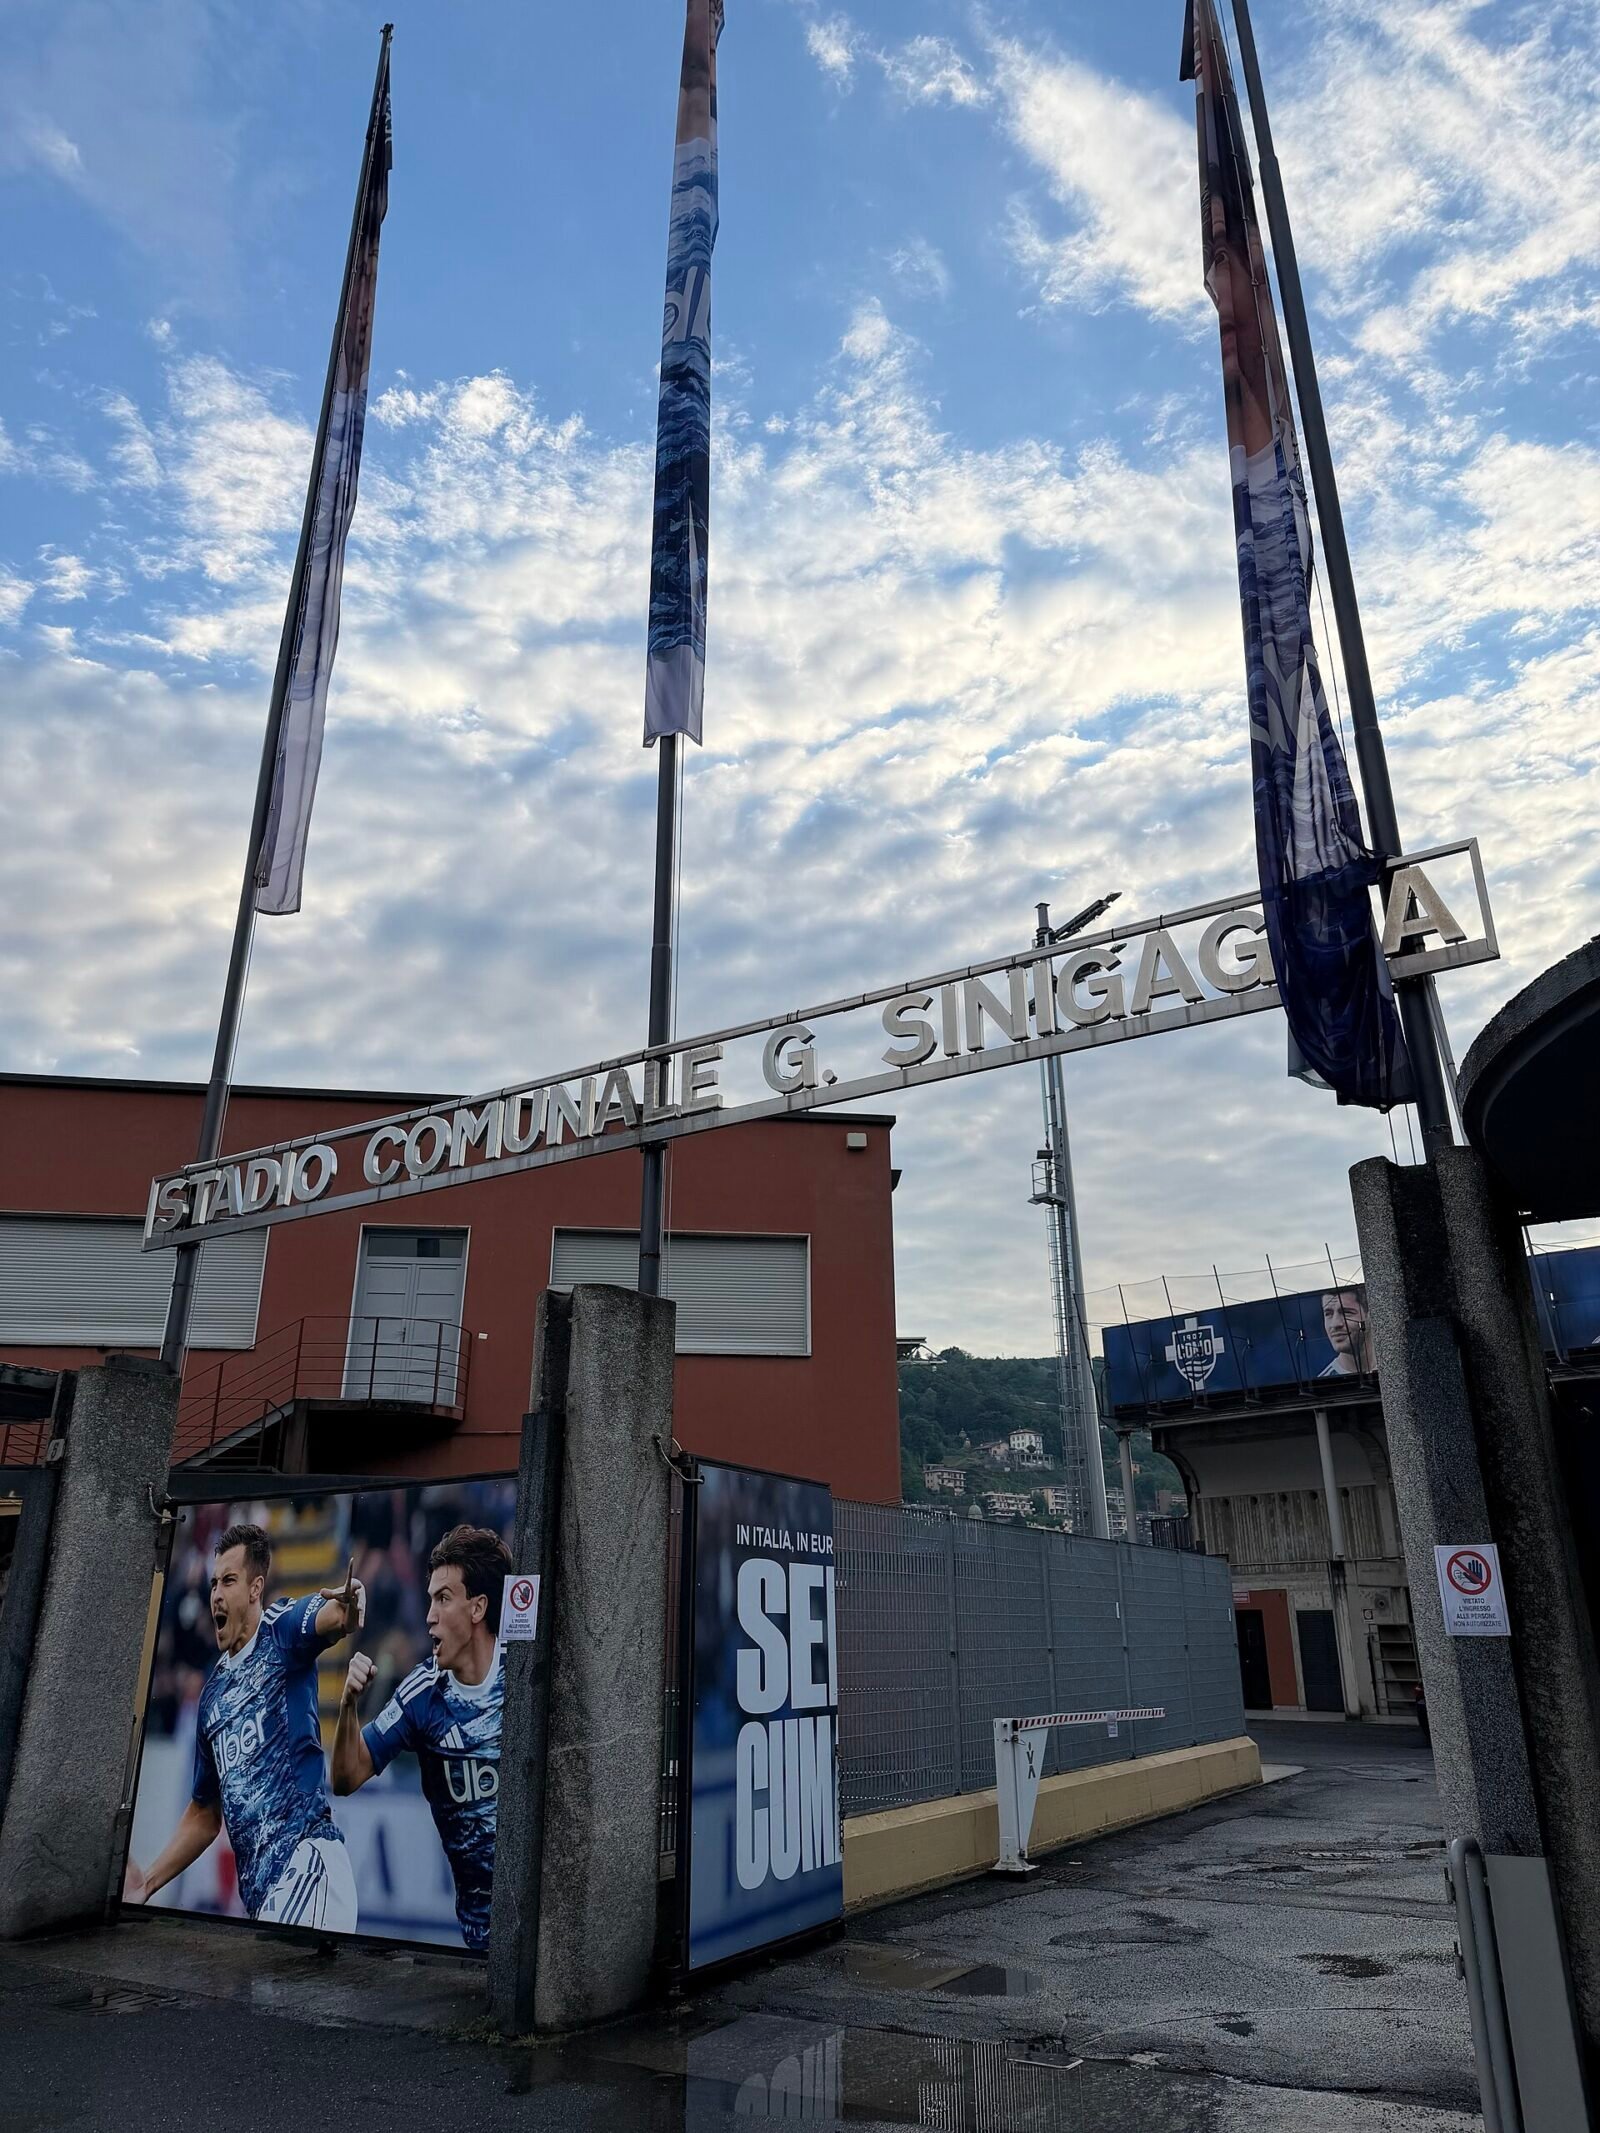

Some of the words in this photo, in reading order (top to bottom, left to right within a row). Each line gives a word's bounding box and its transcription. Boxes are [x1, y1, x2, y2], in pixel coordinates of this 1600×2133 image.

[154, 1144, 338, 1232] STADIO
[362, 1044, 724, 1186] COMUNALE
[762, 1023, 838, 1095] G.
[881, 864, 1467, 1068] SINIGAGA
[1177, 1339, 1212, 1359] COMO
[736, 1524, 750, 1546] IN
[753, 1526, 795, 1553] ITALIA,
[796, 1531, 809, 1552] IN
[811, 1533, 834, 1555] EUR
